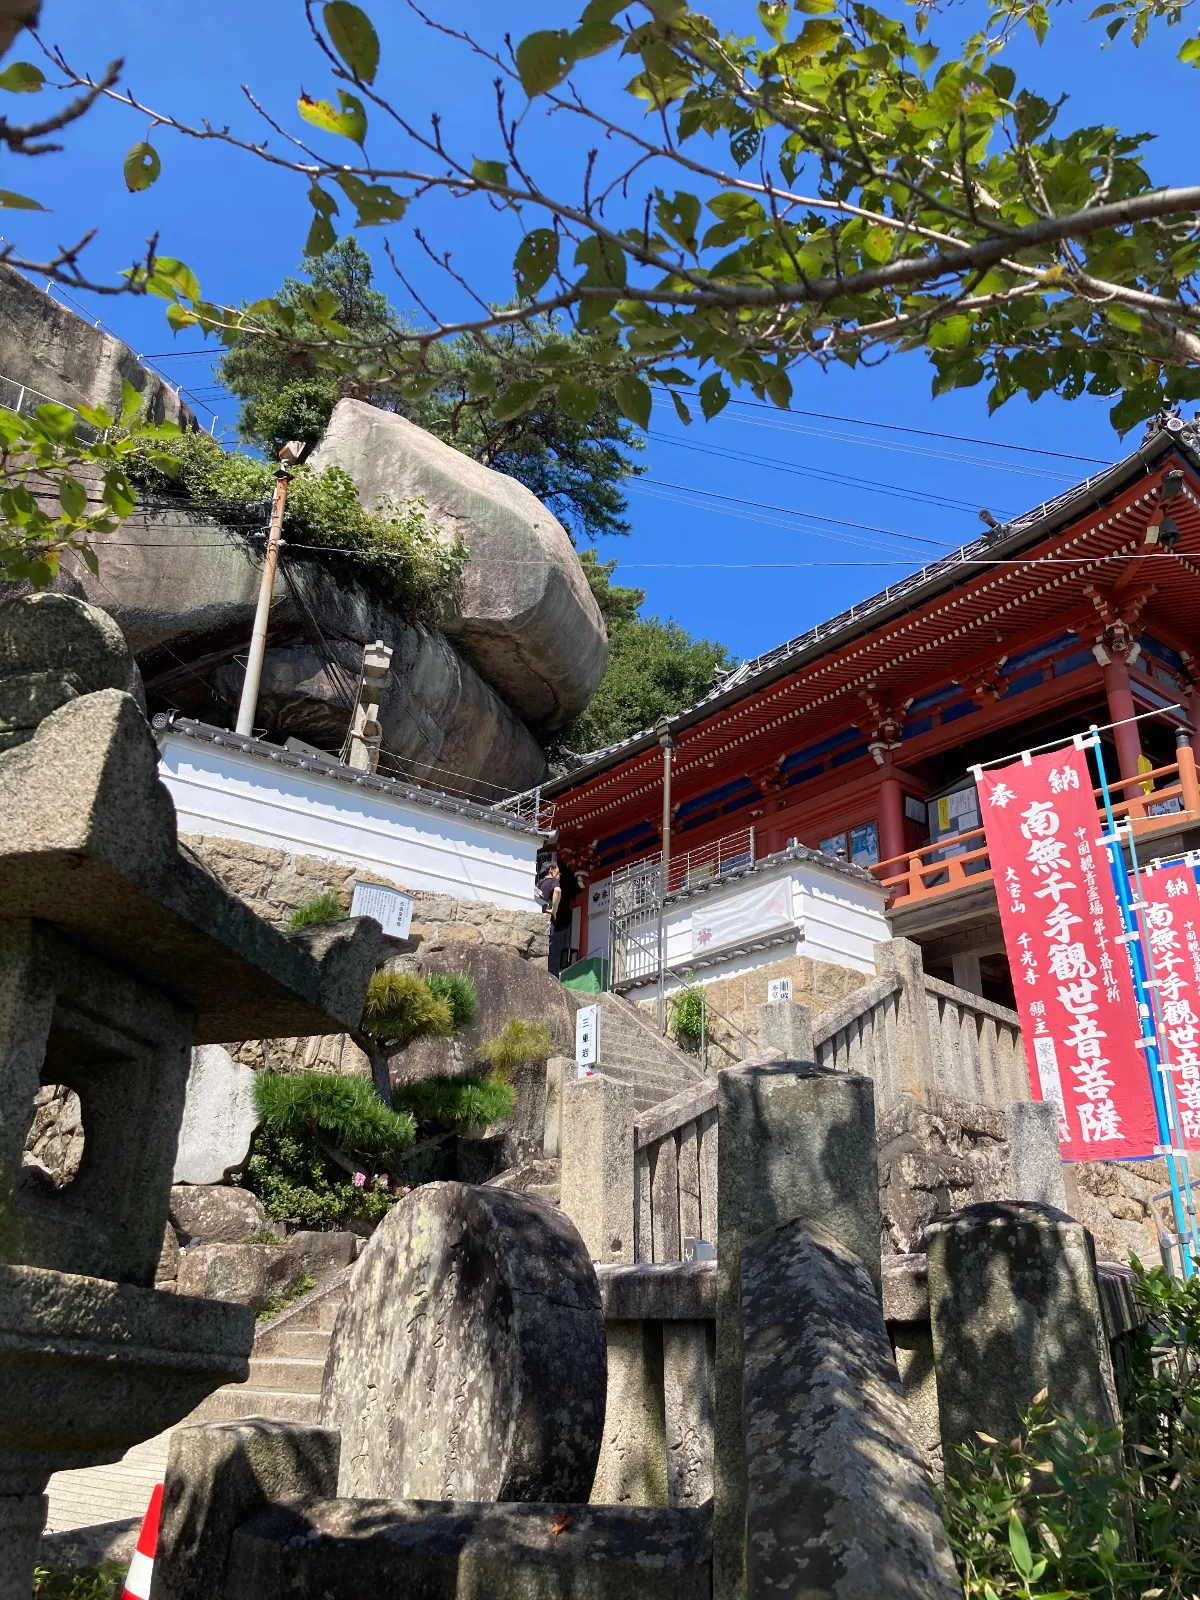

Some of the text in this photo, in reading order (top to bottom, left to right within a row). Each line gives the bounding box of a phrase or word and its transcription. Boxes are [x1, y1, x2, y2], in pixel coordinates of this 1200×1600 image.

[988, 783, 1017, 808] 奉
[1048, 765, 1080, 794] 納
[1165, 877, 1189, 899] 納
[1004, 866, 1050, 1035] 大宝山 千光寺 願主
[1020, 801, 1126, 1143] 南無千手観世音菩薩
